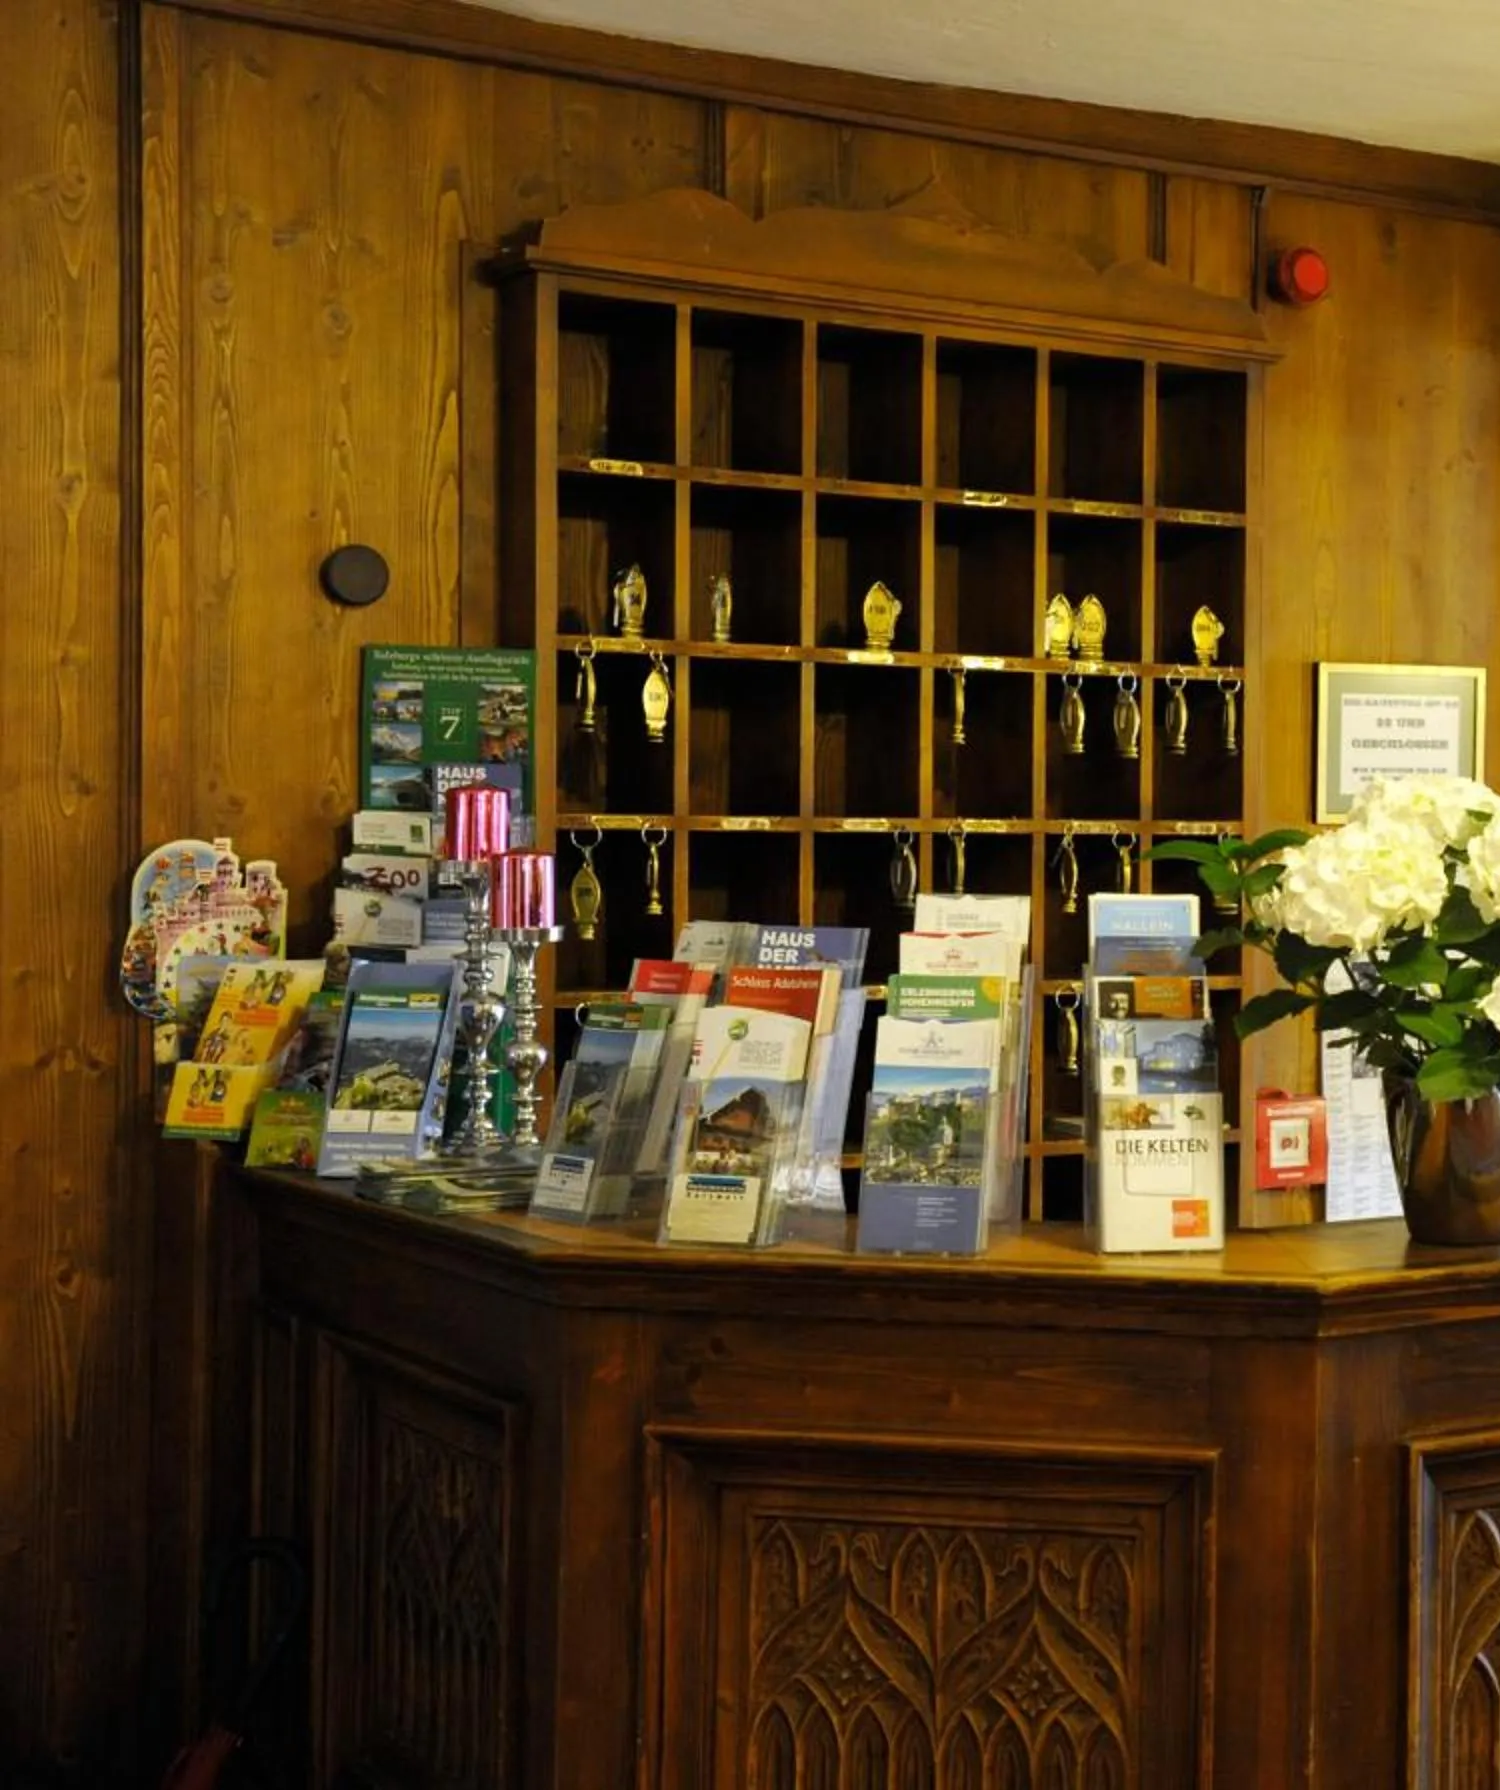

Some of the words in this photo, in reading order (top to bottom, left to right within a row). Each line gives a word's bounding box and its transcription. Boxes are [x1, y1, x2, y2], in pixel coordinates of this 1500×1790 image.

[440, 715, 460, 739] 7
[437, 767, 487, 780] HAUS
[761, 930, 816, 948] HAUS
[759, 947, 799, 964] DER
[1115, 1139, 1143, 1154] DIE
[1147, 1137, 1209, 1153] KELTEN
